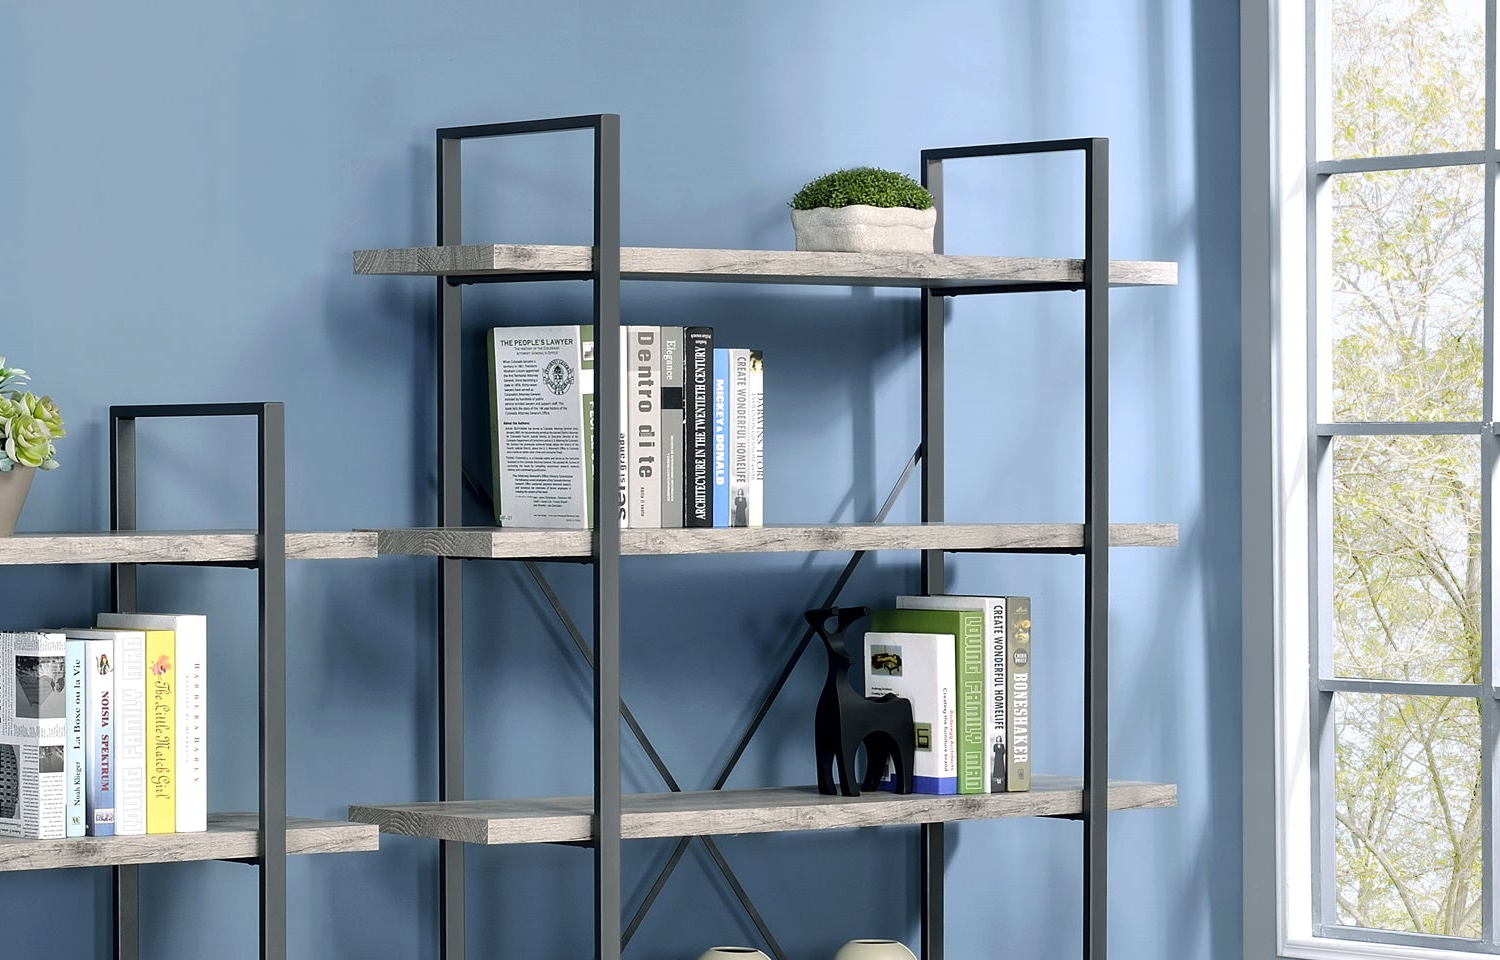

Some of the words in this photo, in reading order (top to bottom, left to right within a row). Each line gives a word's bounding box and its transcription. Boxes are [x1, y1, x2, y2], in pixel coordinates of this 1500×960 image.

[638, 332, 654, 413] Dentro
[663, 340, 676, 380] Elegance
[694, 346, 706, 384] CENTURY
[736, 356, 746, 386] CREATE
[694, 385, 706, 431] TWENTIETH
[715, 379, 725, 426] MICKEY
[736, 388, 746, 440] WONDERFUL
[639, 425, 655, 447] di
[694, 432, 706, 448] THE
[694, 449, 706, 459] IN
[639, 456, 655, 478] te
[715, 434, 725, 485] DONALD
[736, 442, 746, 483] HOMELIFE
[993, 605, 1003, 634] CREATE
[994, 636, 1004, 687] WONDERFUL
[154, 680, 171, 701] The
[994, 690, 1004, 730] HOMELIFE
[965, 680, 983, 744] FAMILY
[1013, 672, 1028, 764] BONESHAKER
[101, 734, 110, 792] SPEKTRUM
[155, 735, 171, 773] Match
[151, 775, 171, 800] Girl
